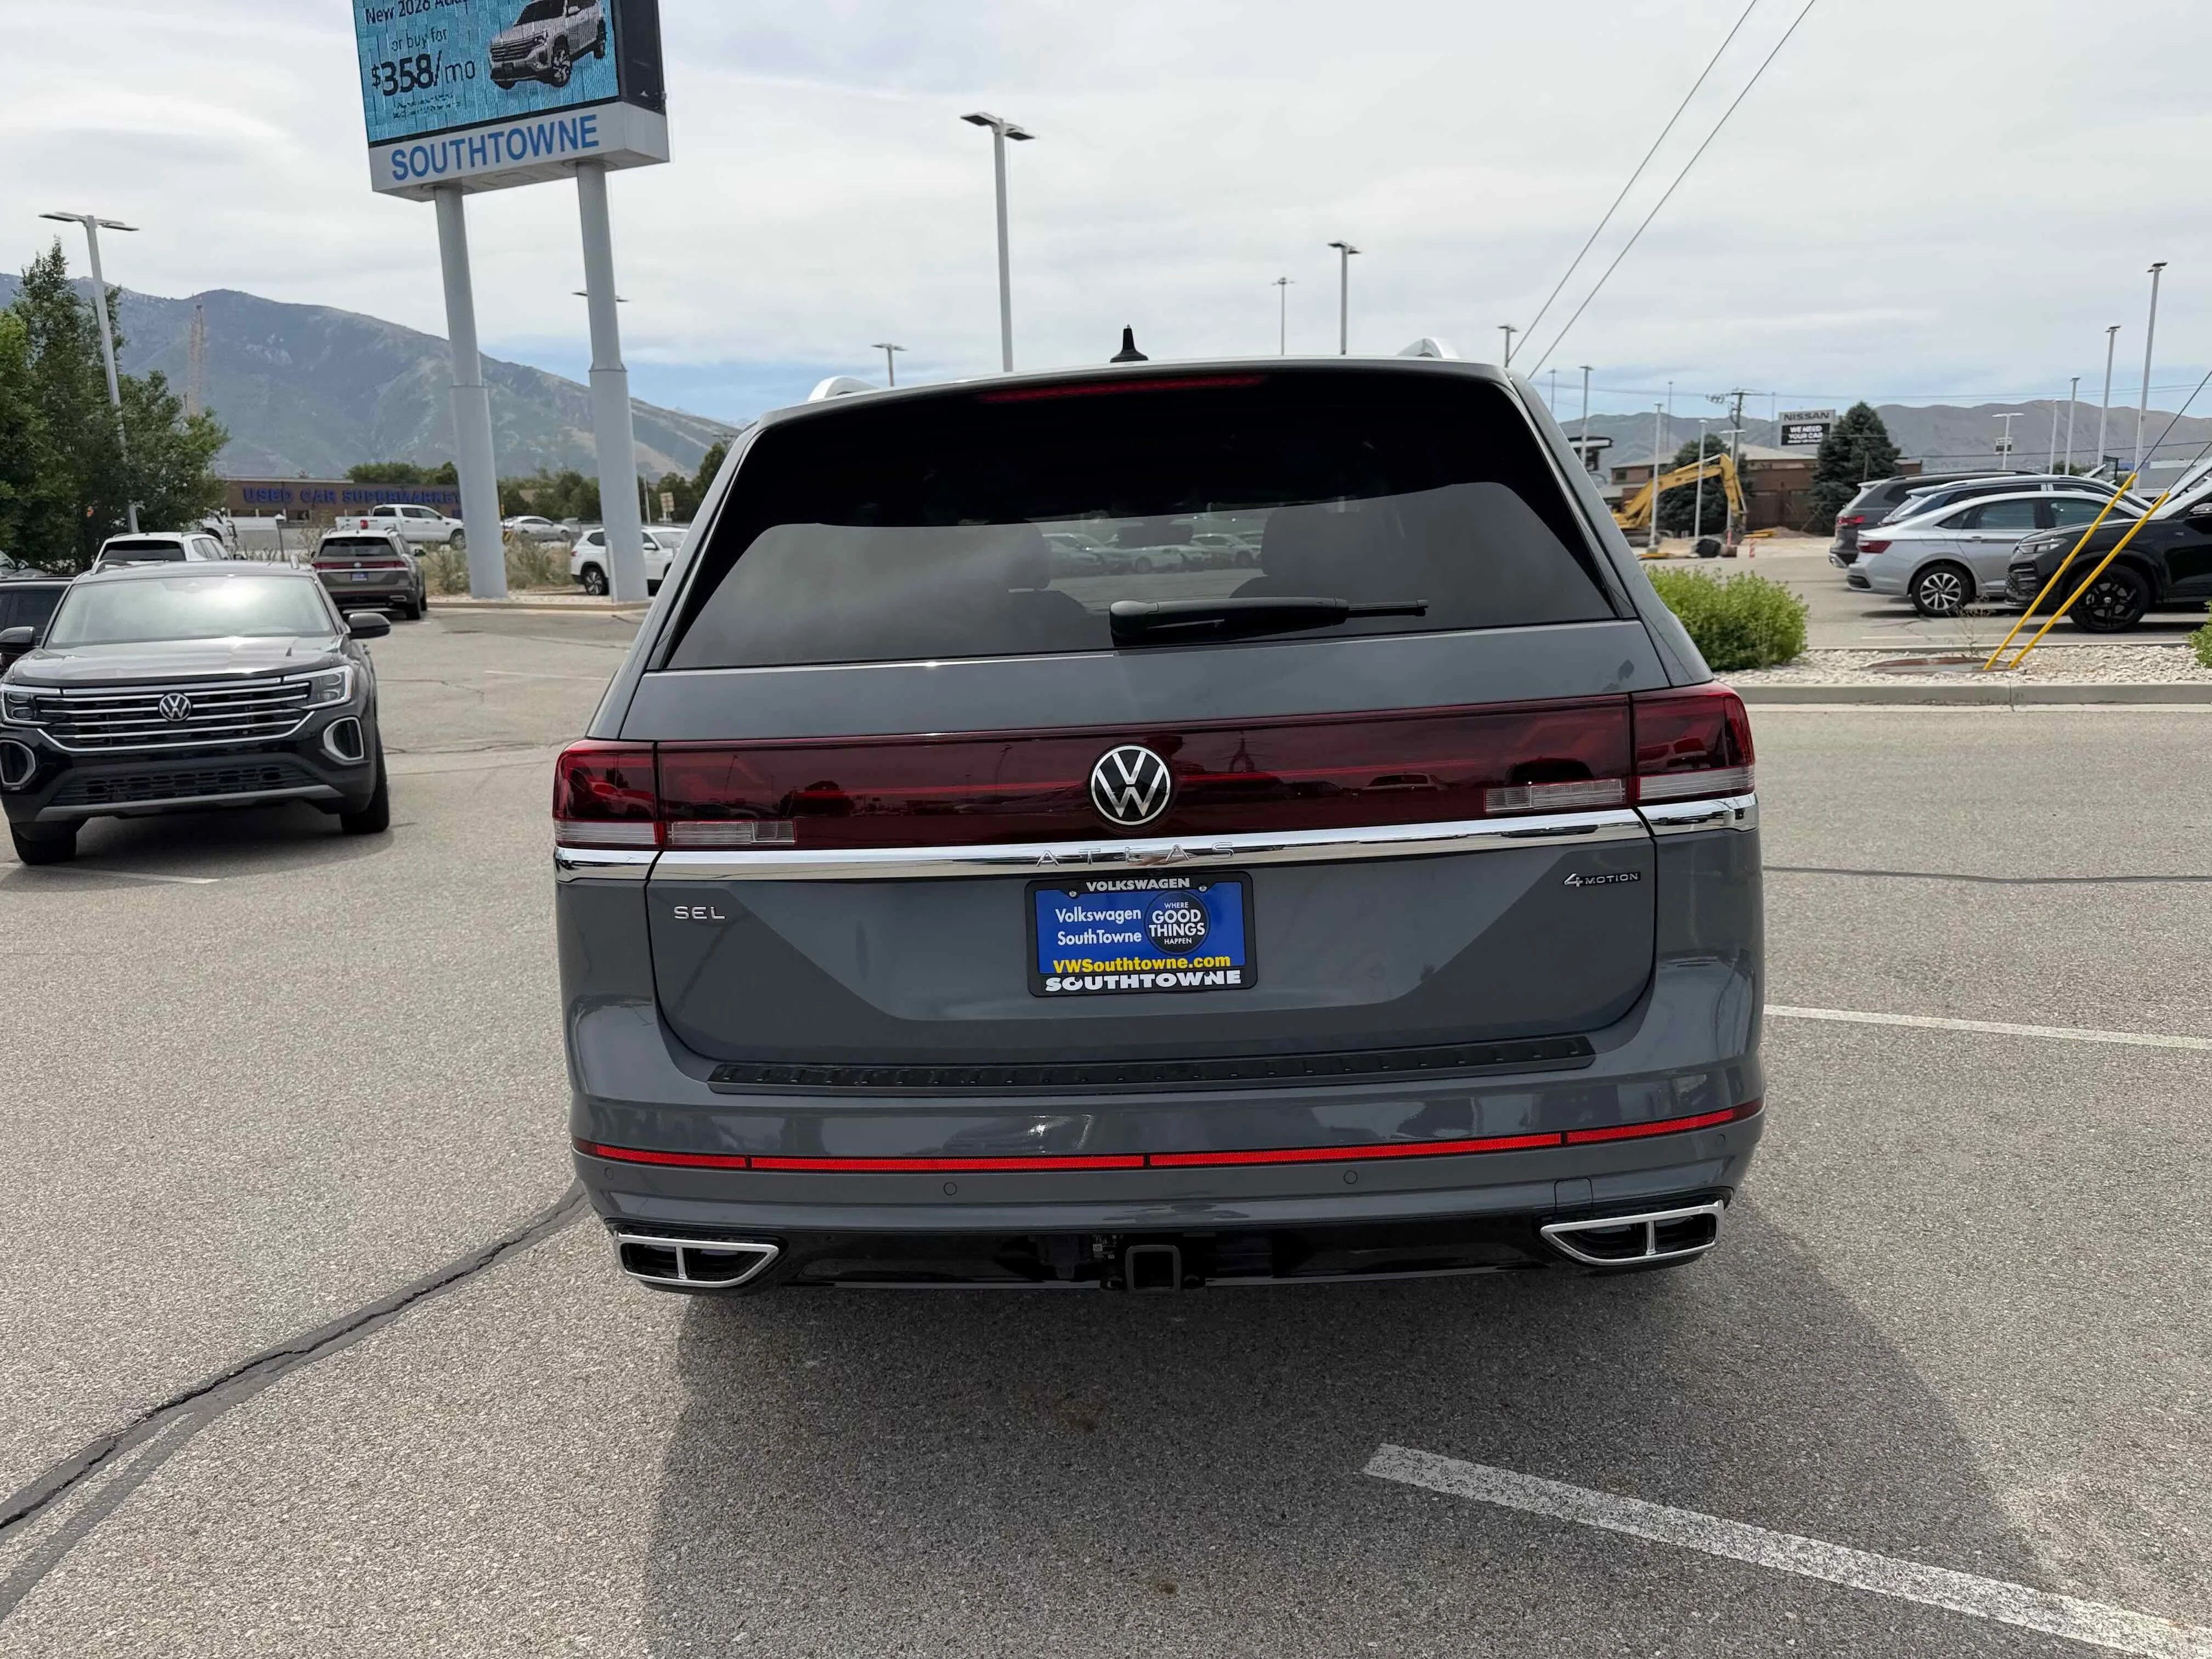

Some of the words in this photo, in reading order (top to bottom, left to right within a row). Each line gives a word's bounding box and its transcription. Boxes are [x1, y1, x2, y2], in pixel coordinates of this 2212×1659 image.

[365, 7, 394, 25] New
[392, 38, 403, 52] or
[406, 29, 428, 49] buy
[430, 27, 447, 43] for
[391, 114, 599, 181] SOUTHTOWNE
[1784, 412, 1830, 421] NISSAN
[243, 487, 293, 503] USED
[300, 488, 337, 504] CAR
[1035, 841, 1234, 867] ATLAS
[1086, 877, 1190, 892] VOLKSWAGEN
[674, 906, 725, 920] SEL
[1056, 907, 1142, 925] Volkswagen
[1152, 909, 1201, 924] GOOD
[1057, 929, 1142, 946] SouthTowne
[1149, 922, 1205, 937] THINGS
[1053, 955, 1231, 974] VWSouthtowne.com
[1045, 969, 1242, 992] SOUTHTOWNE
